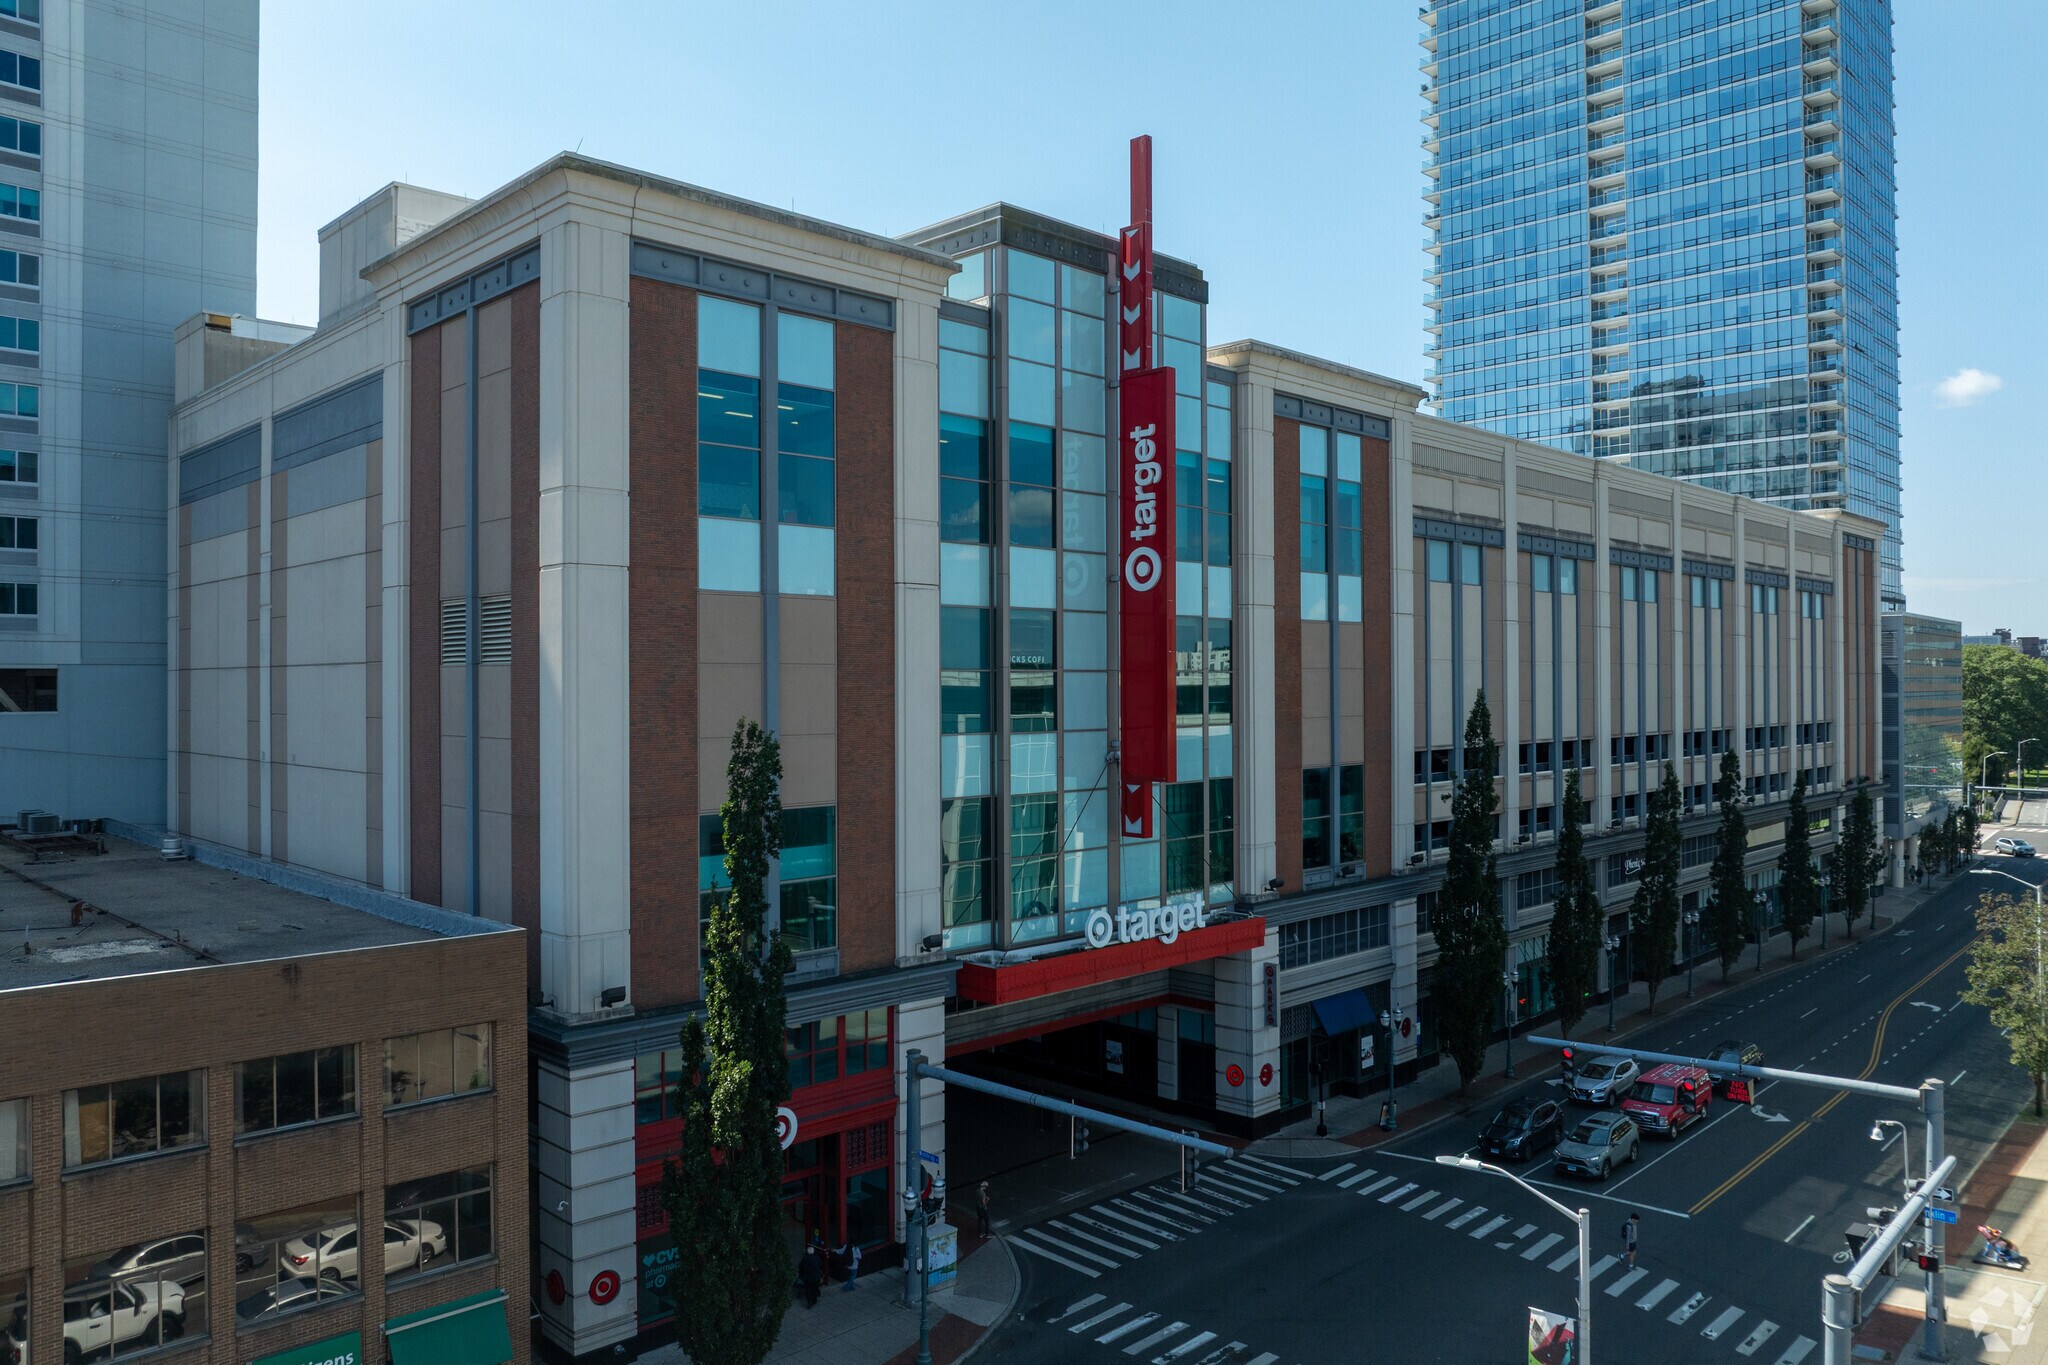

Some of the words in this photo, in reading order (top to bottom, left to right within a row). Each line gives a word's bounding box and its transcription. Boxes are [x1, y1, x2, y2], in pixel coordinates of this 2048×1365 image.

[1129, 423, 1162, 541] target
[1115, 893, 1206, 944] target
[1729, 1086, 1748, 1095] TURN
[1731, 1080, 1745, 1088] NO
[1727, 1092, 1737, 1100] ON
[1737, 1093, 1750, 1102] RED
[645, 1262, 680, 1280] pharmac
